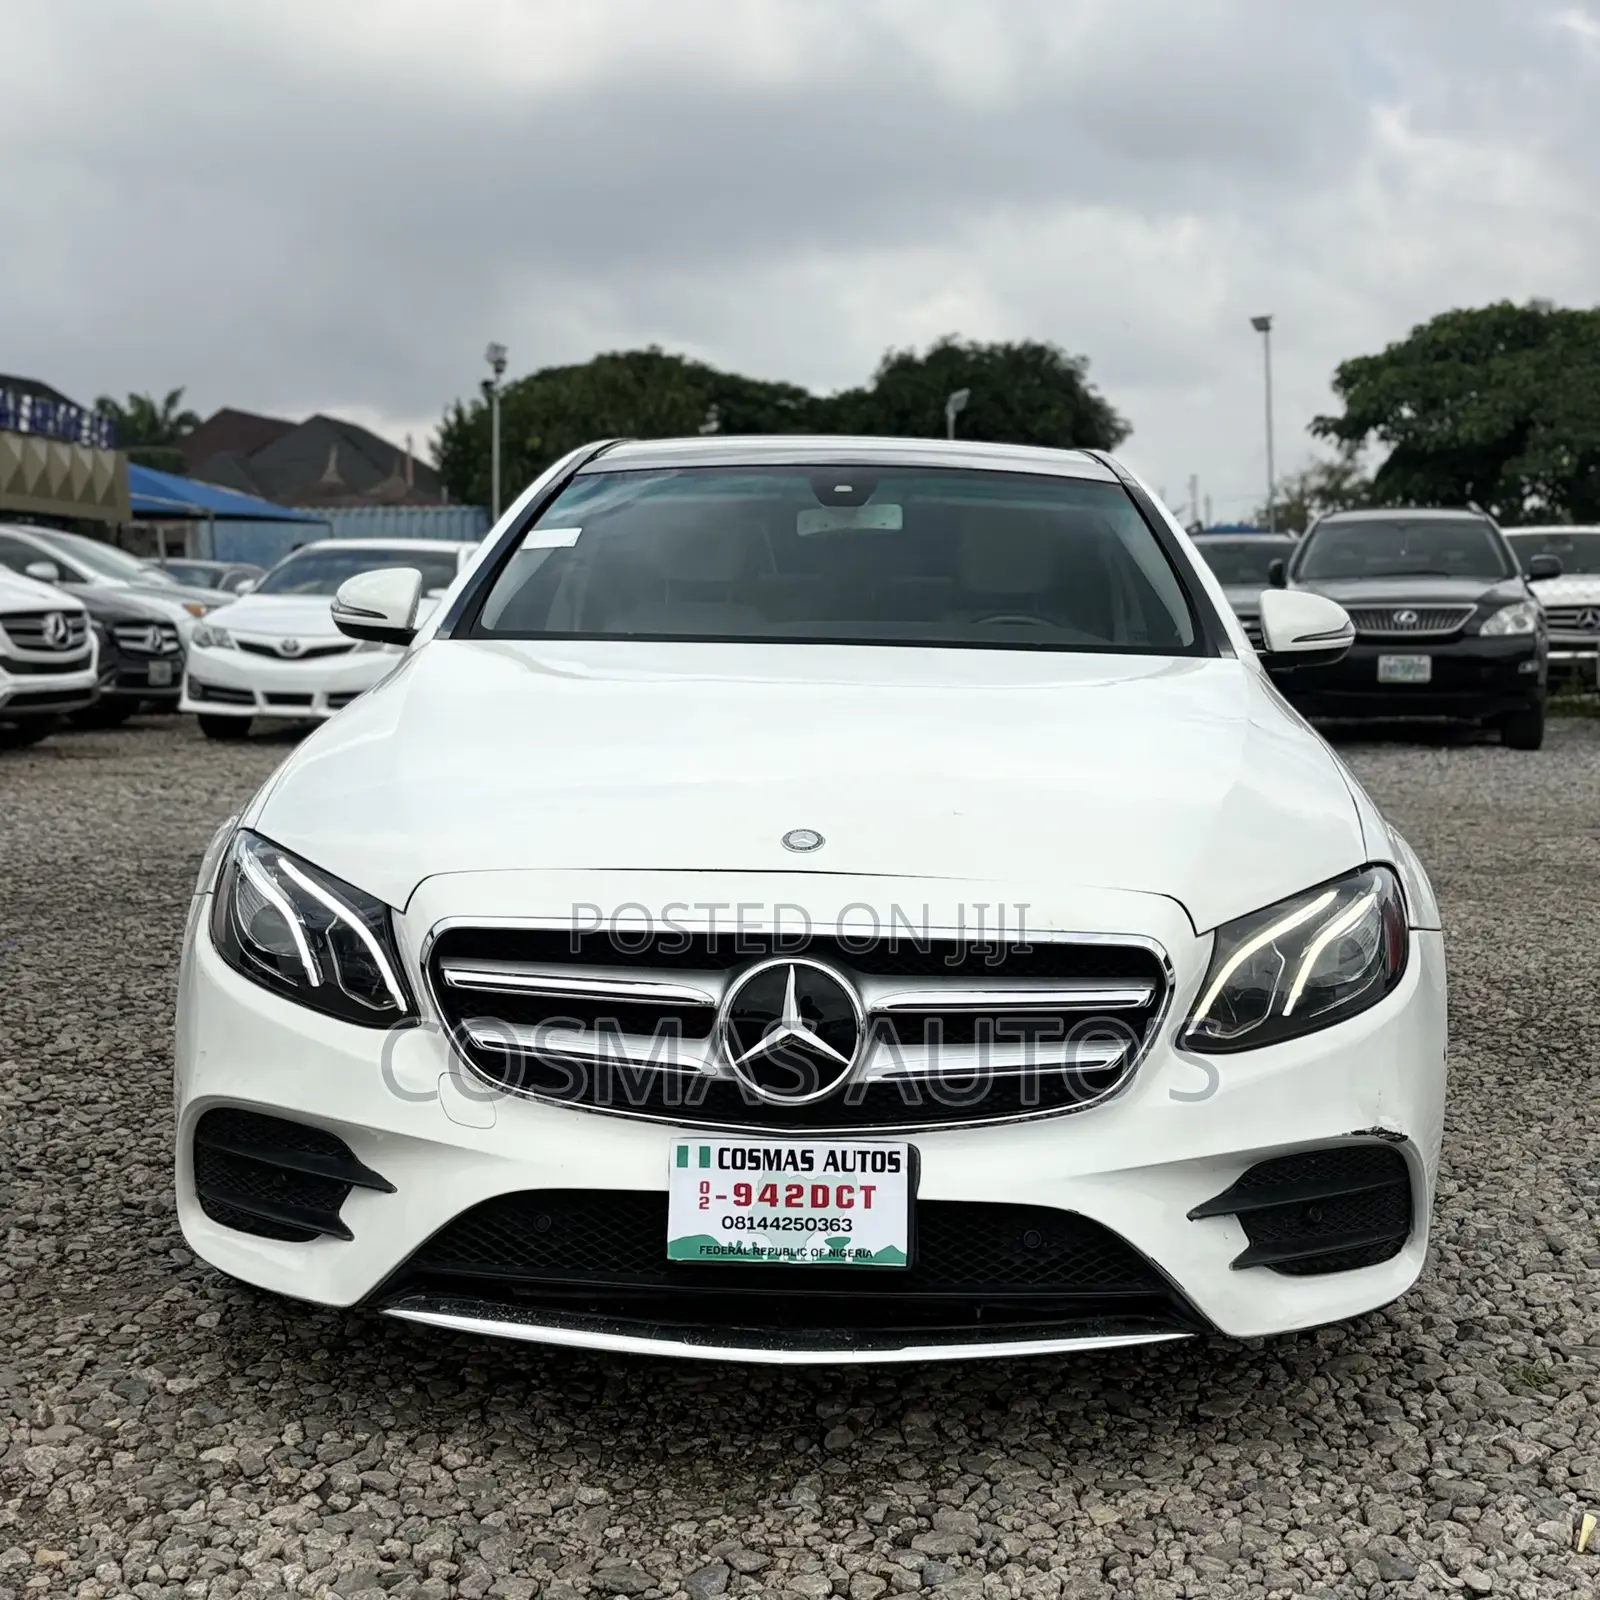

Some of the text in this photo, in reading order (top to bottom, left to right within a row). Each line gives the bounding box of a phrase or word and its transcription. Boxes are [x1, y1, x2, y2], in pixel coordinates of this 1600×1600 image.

[718, 1148, 901, 1173] COSMAS AUTOS
[721, 1215, 853, 1232] 08144250363
[699, 1245, 873, 1259] FEDERAL REPUBLIC OF NIGERIA
